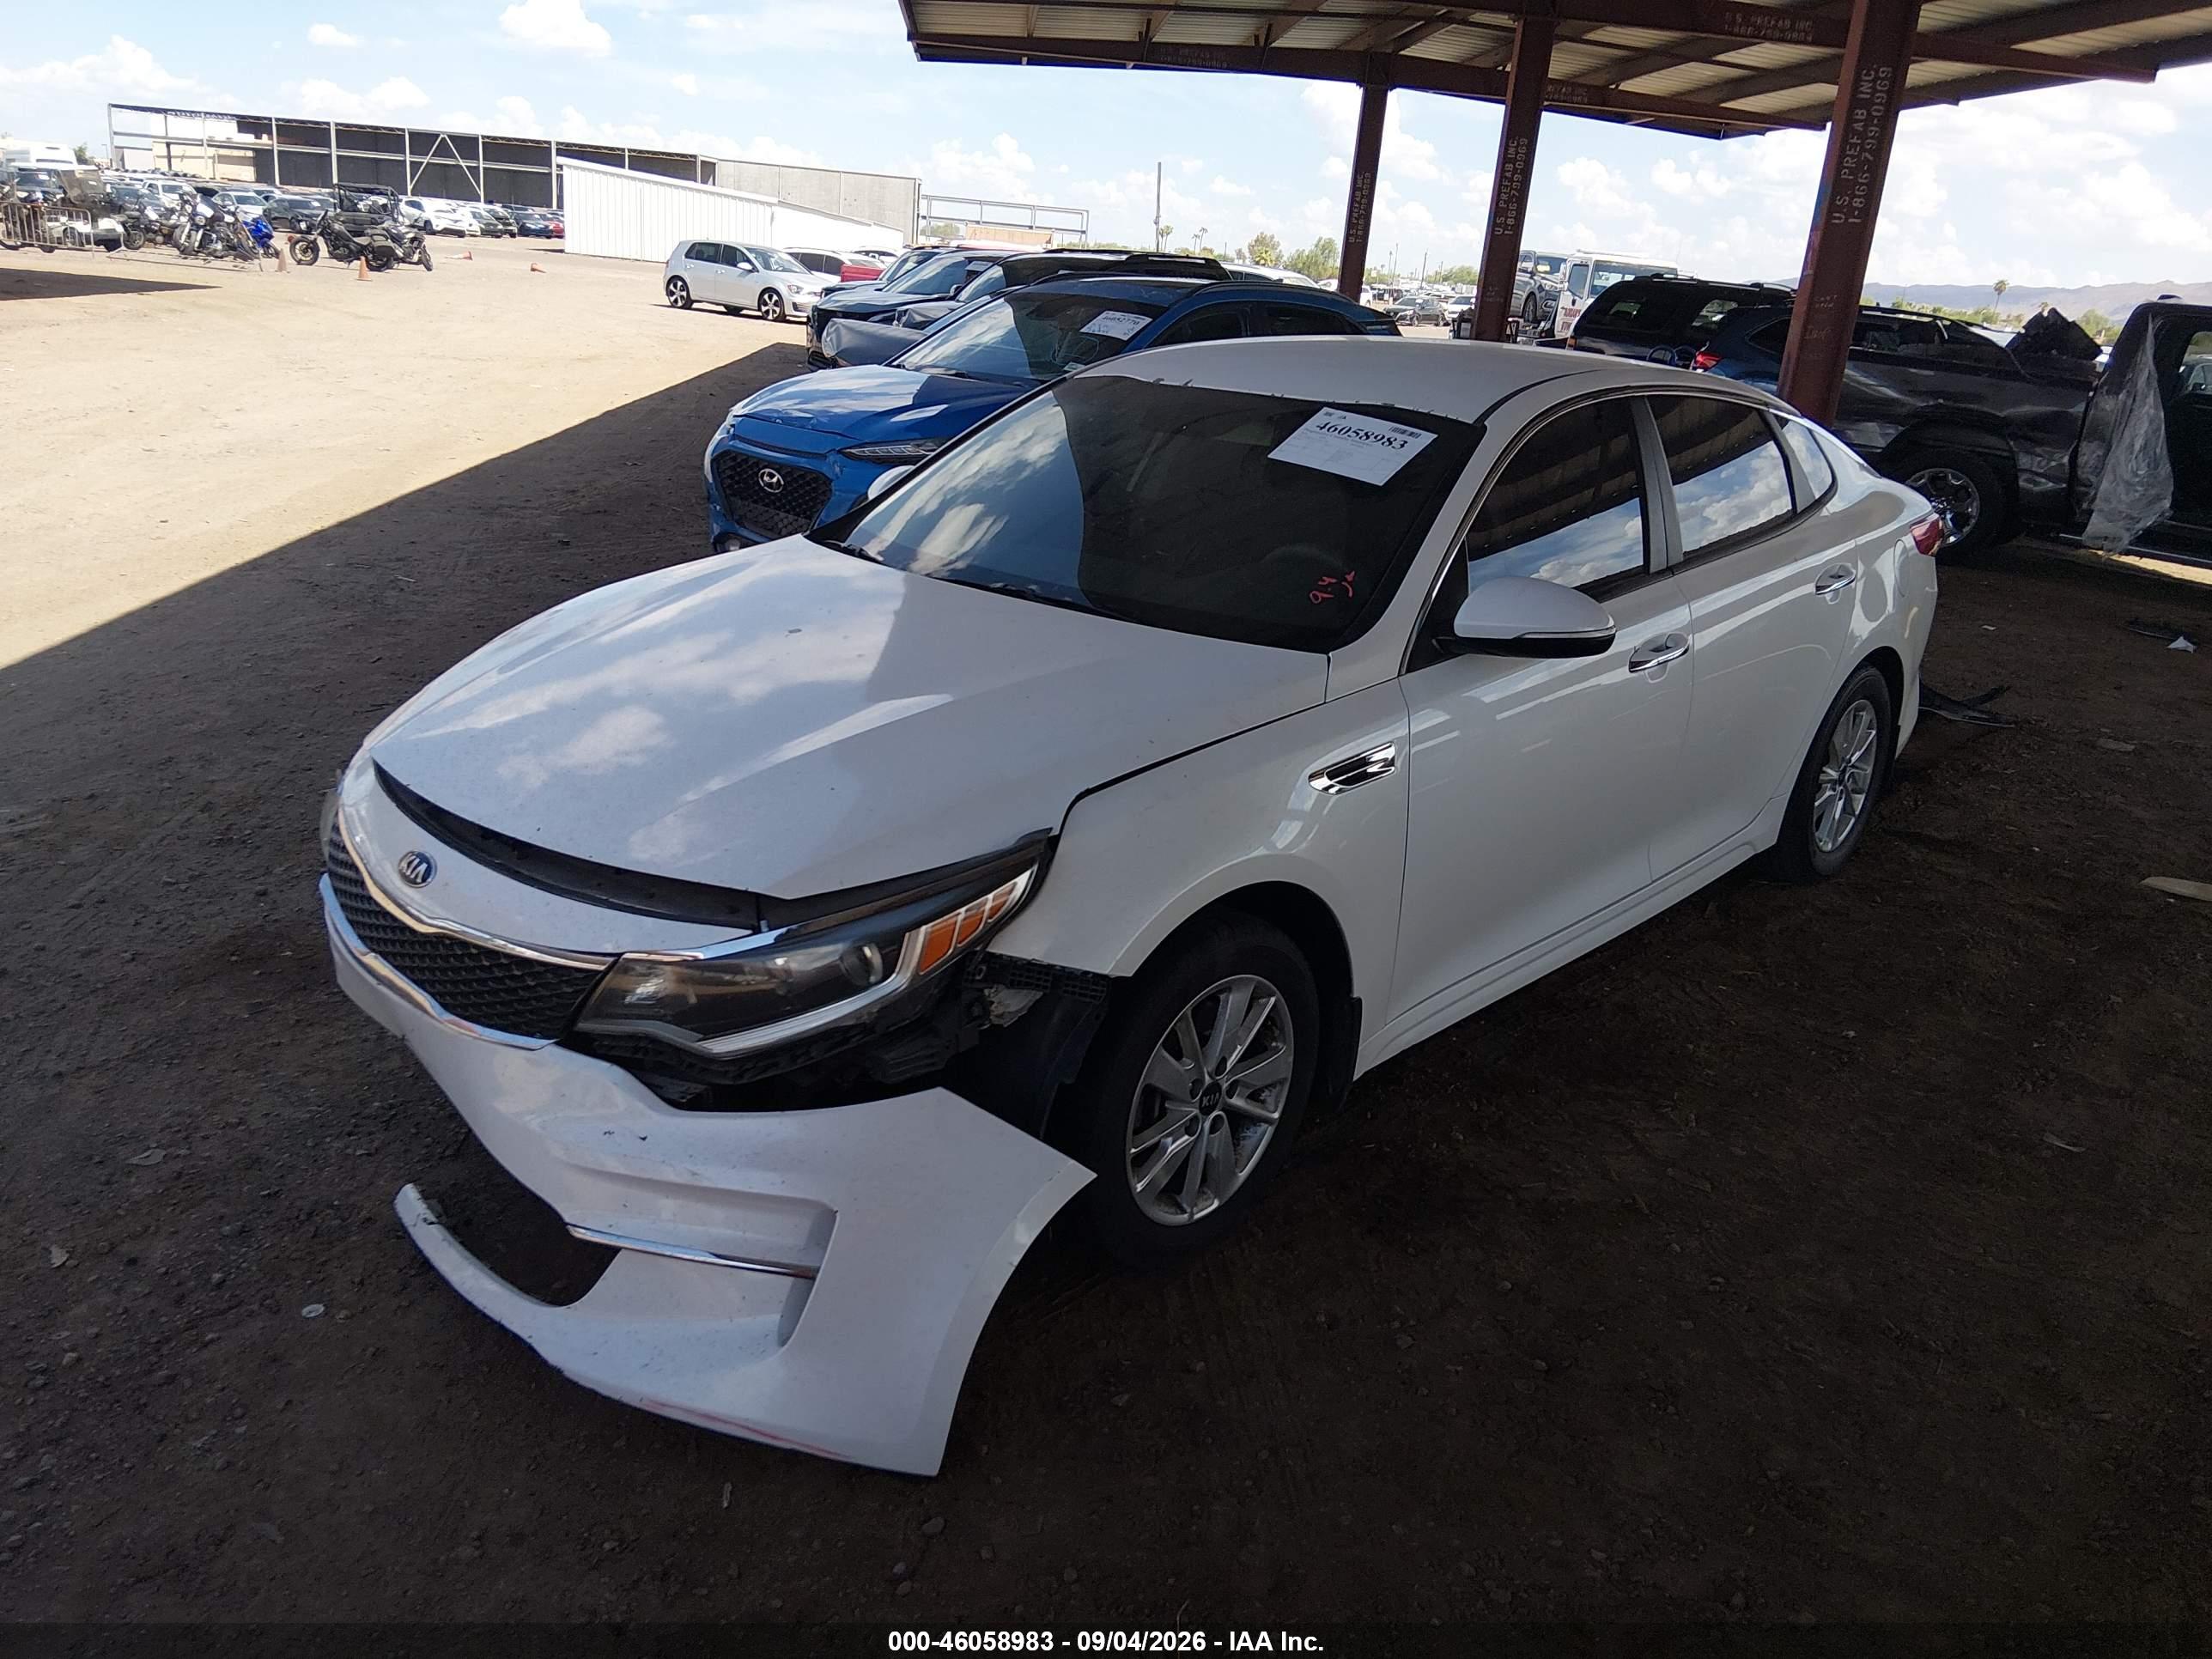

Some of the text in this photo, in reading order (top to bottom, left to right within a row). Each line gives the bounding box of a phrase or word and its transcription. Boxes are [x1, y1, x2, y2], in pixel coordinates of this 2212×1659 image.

[1840, 108, 1868, 179] PREFAB
[1856, 64, 1877, 100] INC.
[1847, 66, 1893, 224] 1-866-799-0969
[1498, 163, 1514, 208] PREFAB
[1504, 137, 1528, 234] 1-866-799-0969
[1316, 421, 1409, 451] 46058983
